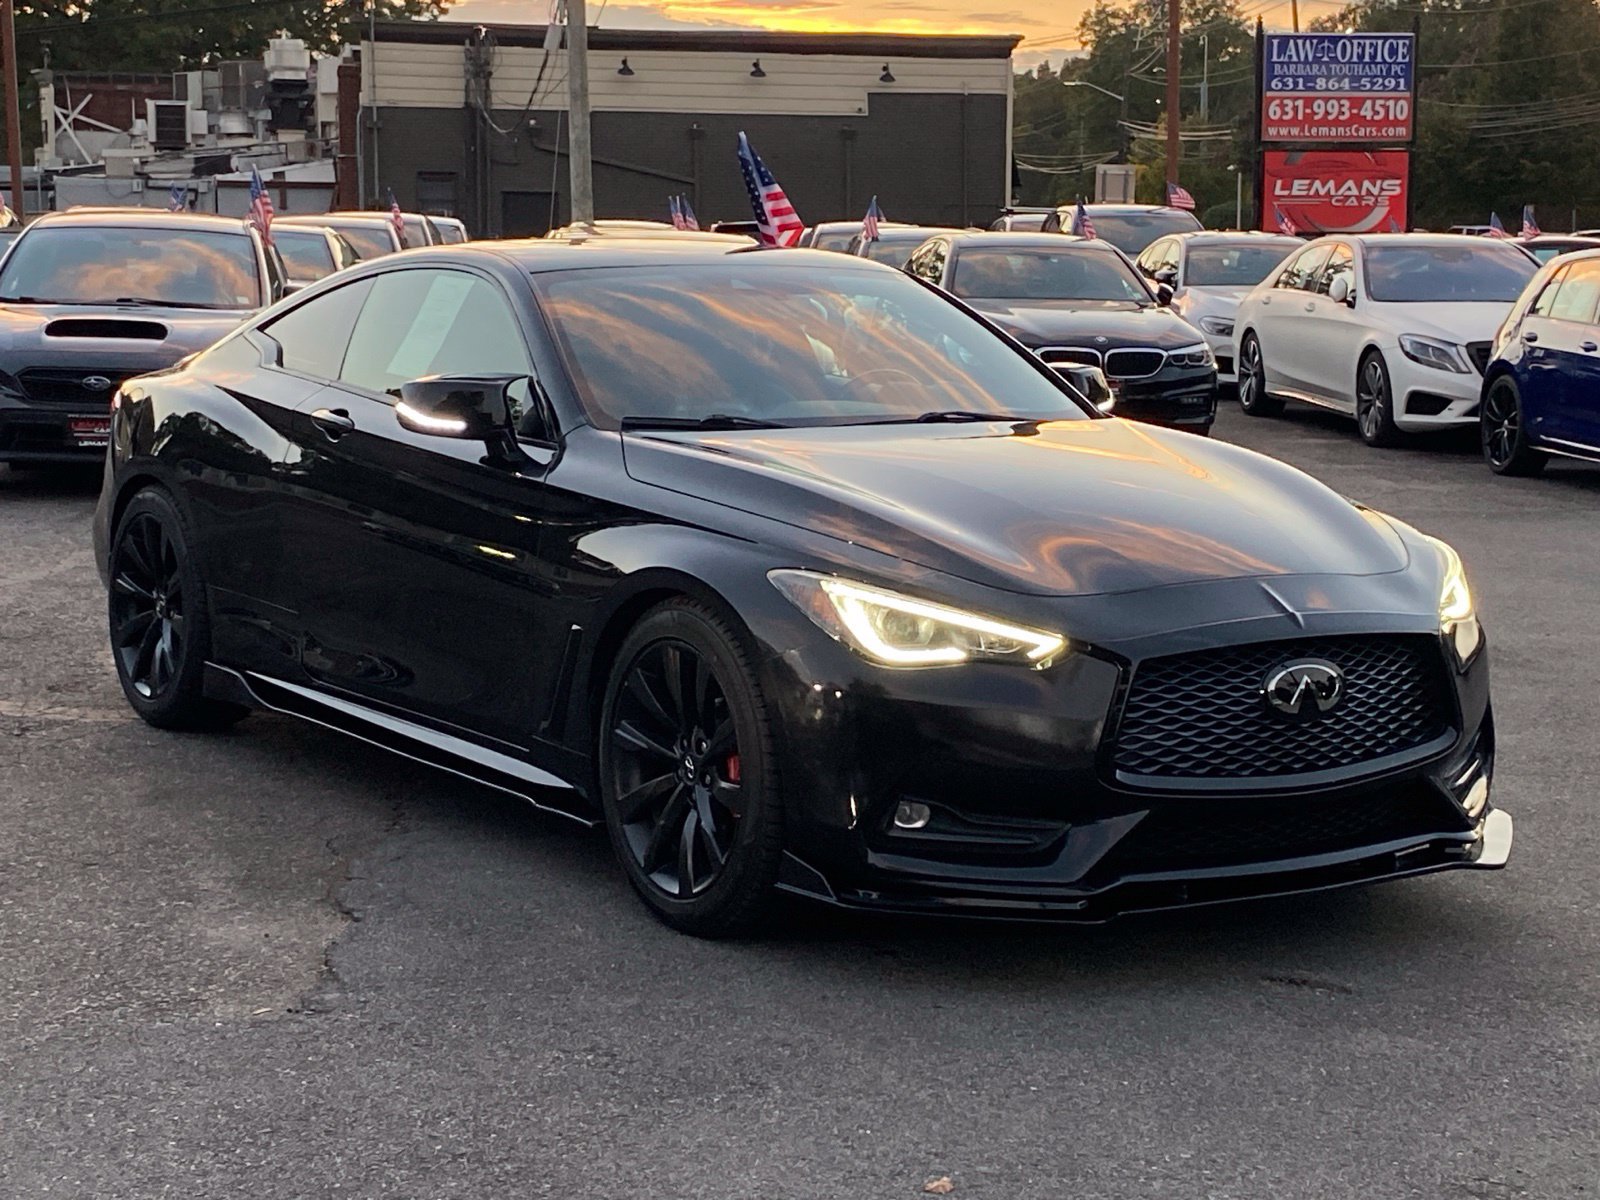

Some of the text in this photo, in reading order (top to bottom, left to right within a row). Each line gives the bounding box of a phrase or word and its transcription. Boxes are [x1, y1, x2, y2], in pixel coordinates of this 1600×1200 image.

[1271, 38, 1410, 62] LAW OFFICE
[1274, 64, 1406, 75] BARBARA TOUHAMY PC
[1271, 77, 1407, 90] 631-864-5291
[1268, 99, 1409, 120] 631-993-4510
[1268, 124, 1407, 137] www.LemansCars.com
[1274, 179, 1402, 196] LEMANS
[1331, 197, 1390, 206] CARS
